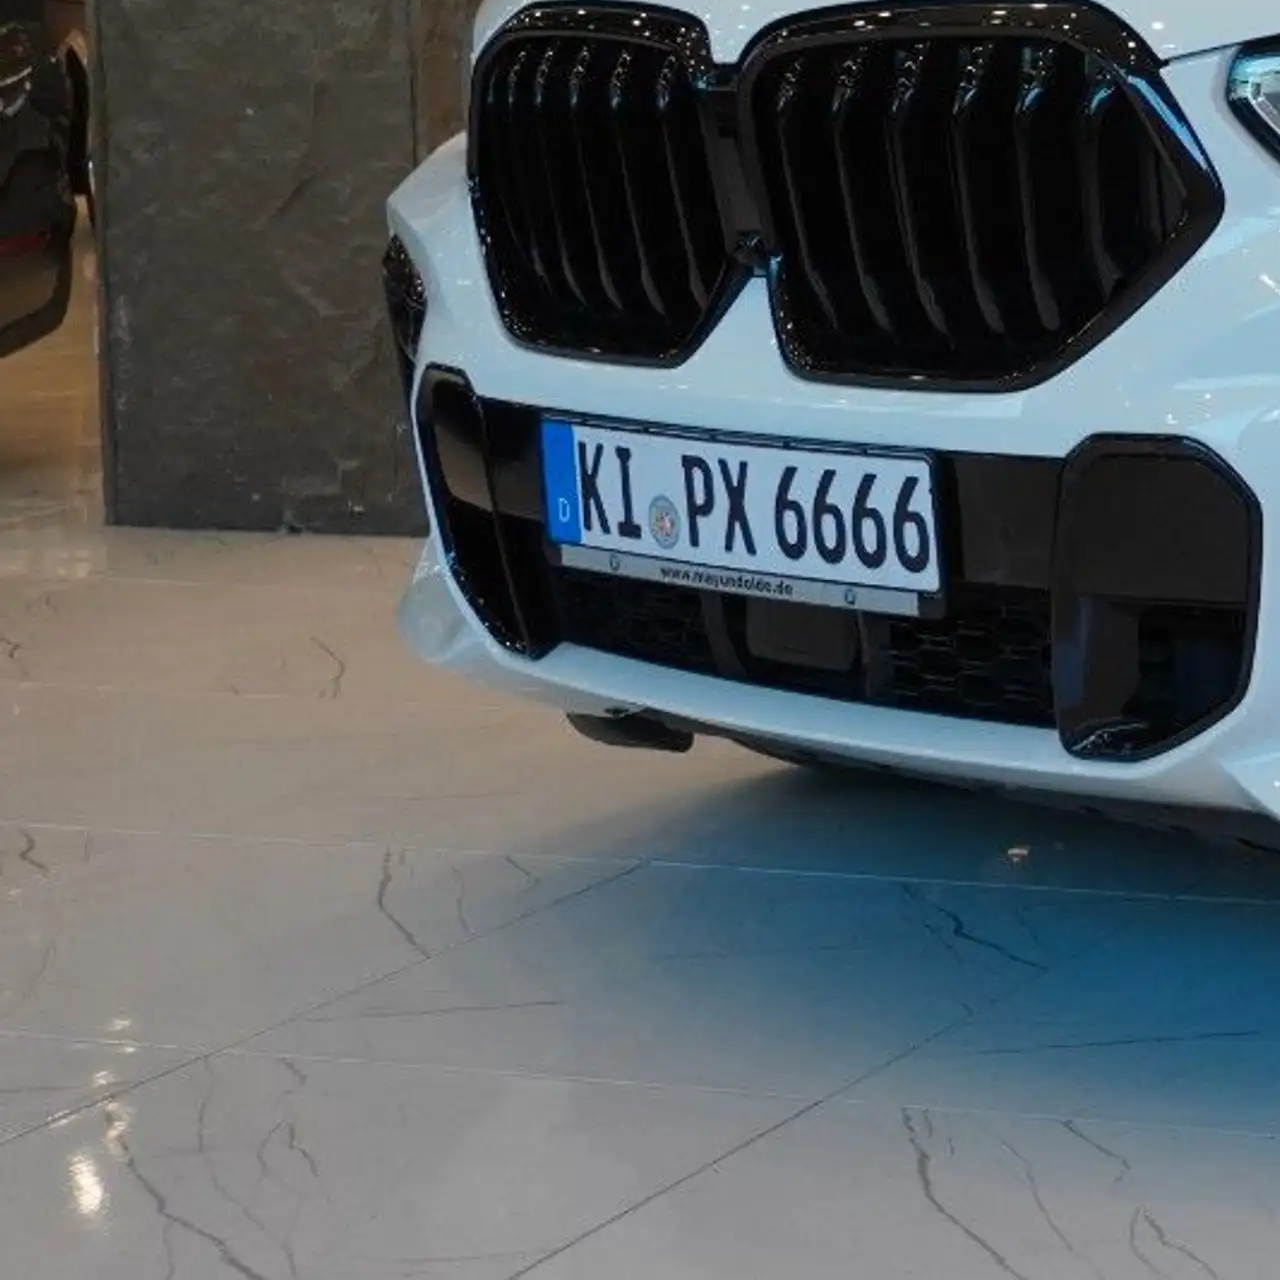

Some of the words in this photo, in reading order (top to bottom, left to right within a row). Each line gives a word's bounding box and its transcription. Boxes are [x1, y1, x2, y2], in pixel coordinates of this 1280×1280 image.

[558, 497, 570, 522] D
[578, 442, 641, 539] KI
[681, 455, 757, 556] PX
[774, 465, 931, 574] 6666
